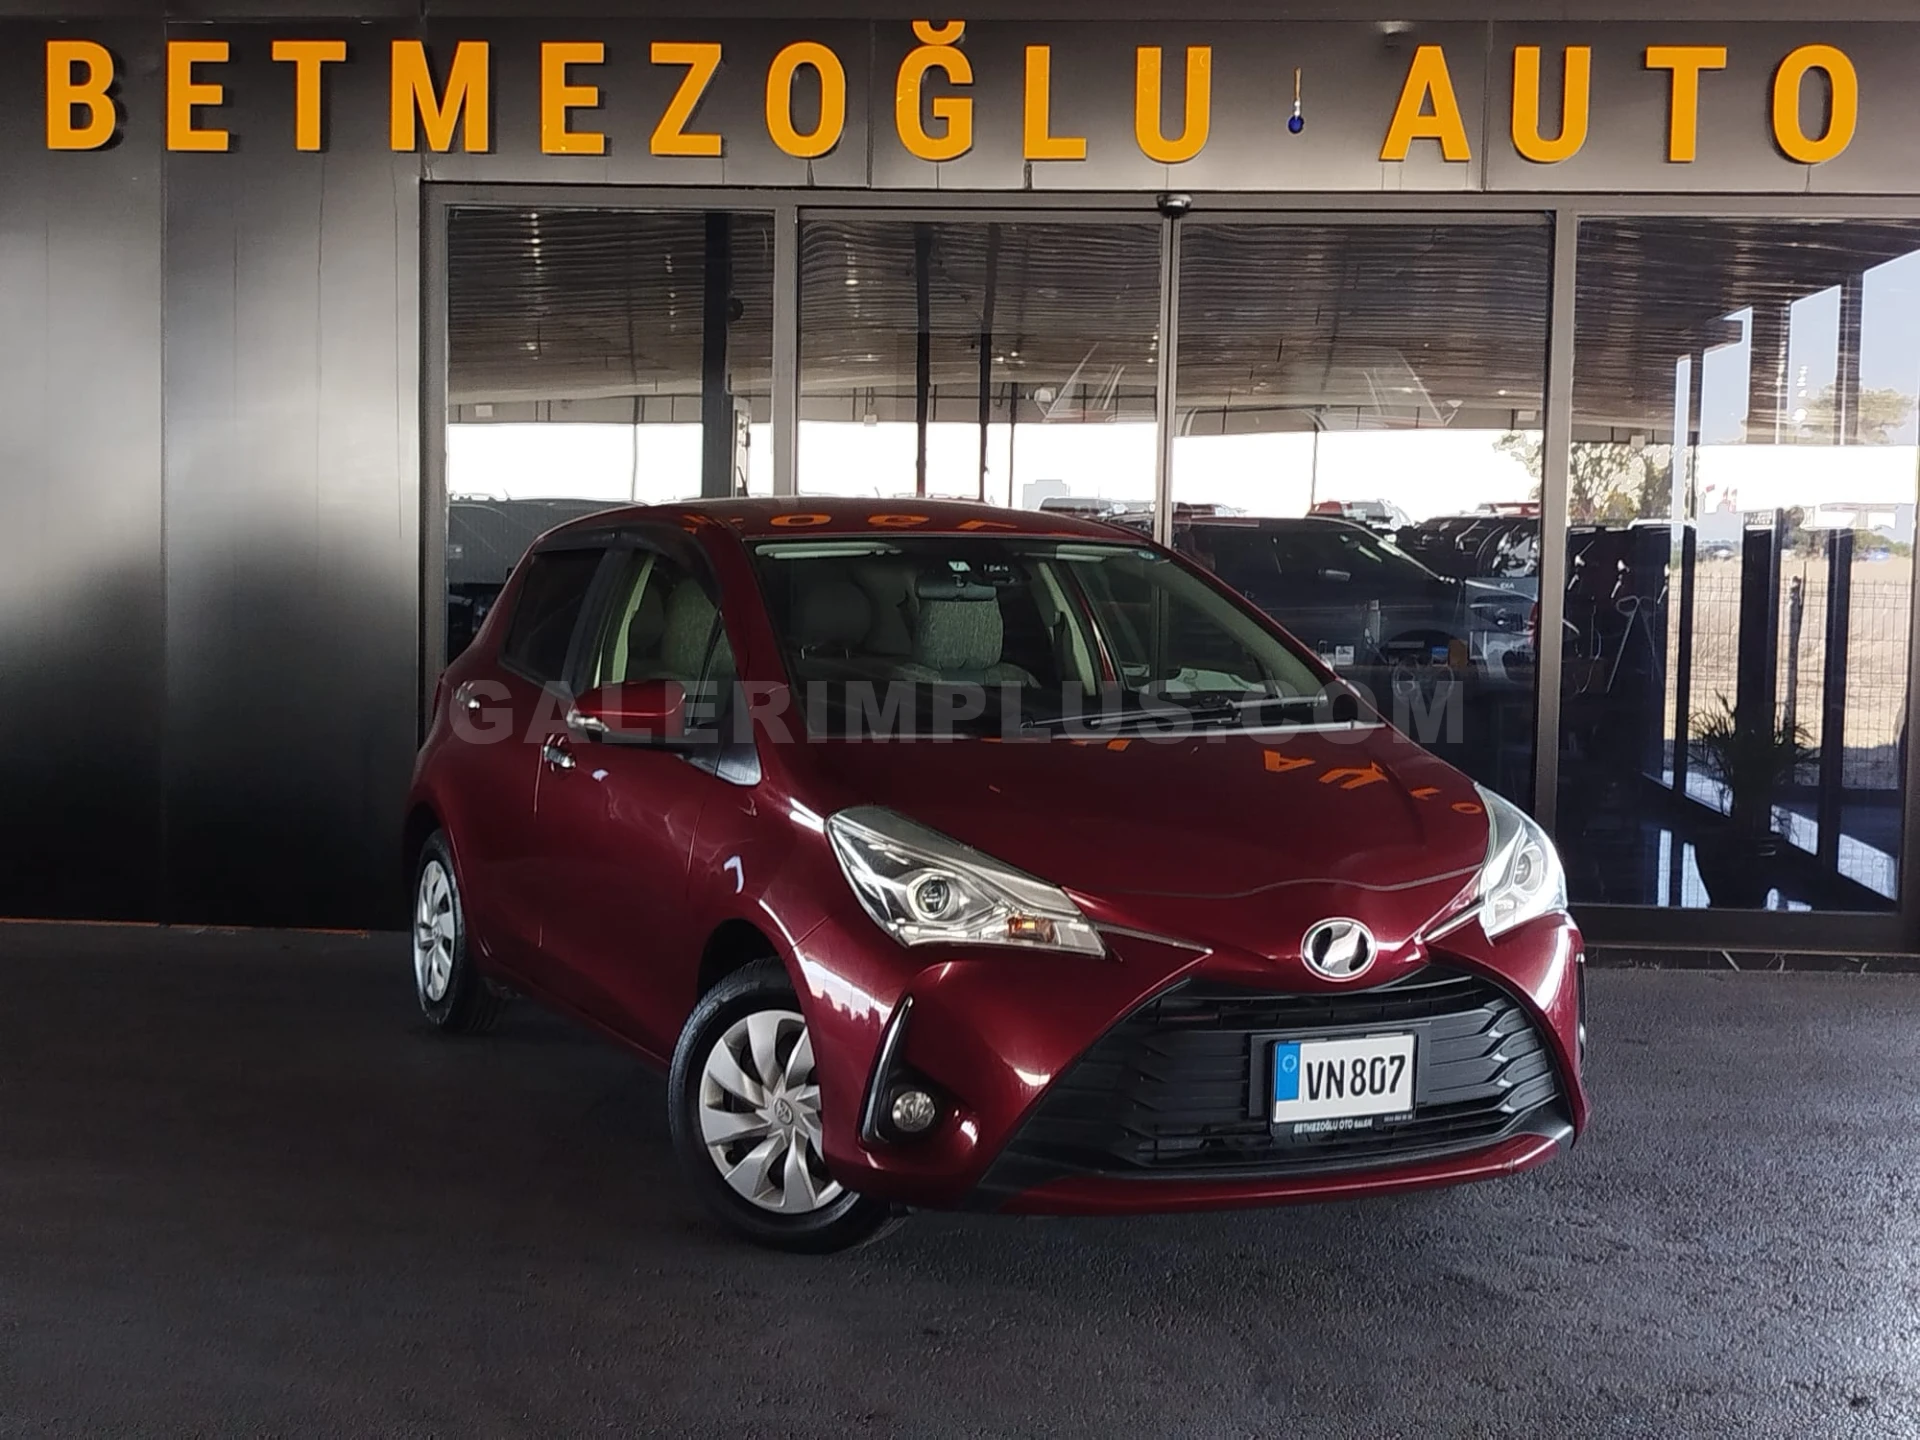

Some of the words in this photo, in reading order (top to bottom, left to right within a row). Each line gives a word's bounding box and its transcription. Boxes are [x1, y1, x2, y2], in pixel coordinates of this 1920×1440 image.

[46, 20, 1212, 162] BETMEZOĞLU
[1380, 43, 1858, 163] AUTO
[1306, 1054, 1406, 1101] VN807
